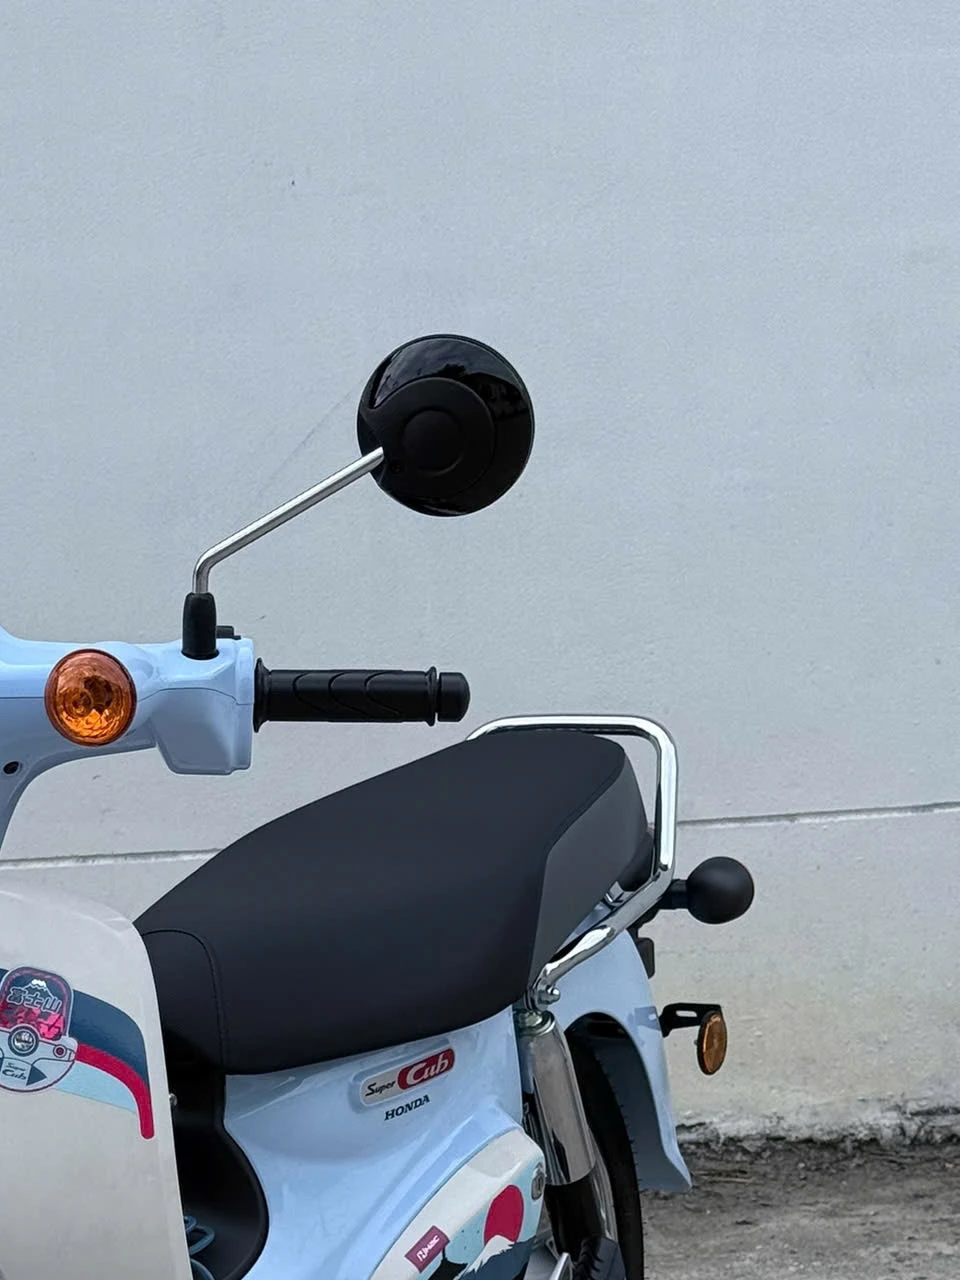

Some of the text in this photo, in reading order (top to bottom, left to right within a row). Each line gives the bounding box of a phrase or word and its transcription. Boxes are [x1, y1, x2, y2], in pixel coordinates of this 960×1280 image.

[1, 1068, 27, 1081] Cub
[365, 1052, 449, 1097] Super Cub
[383, 1094, 431, 1121] HONDA
